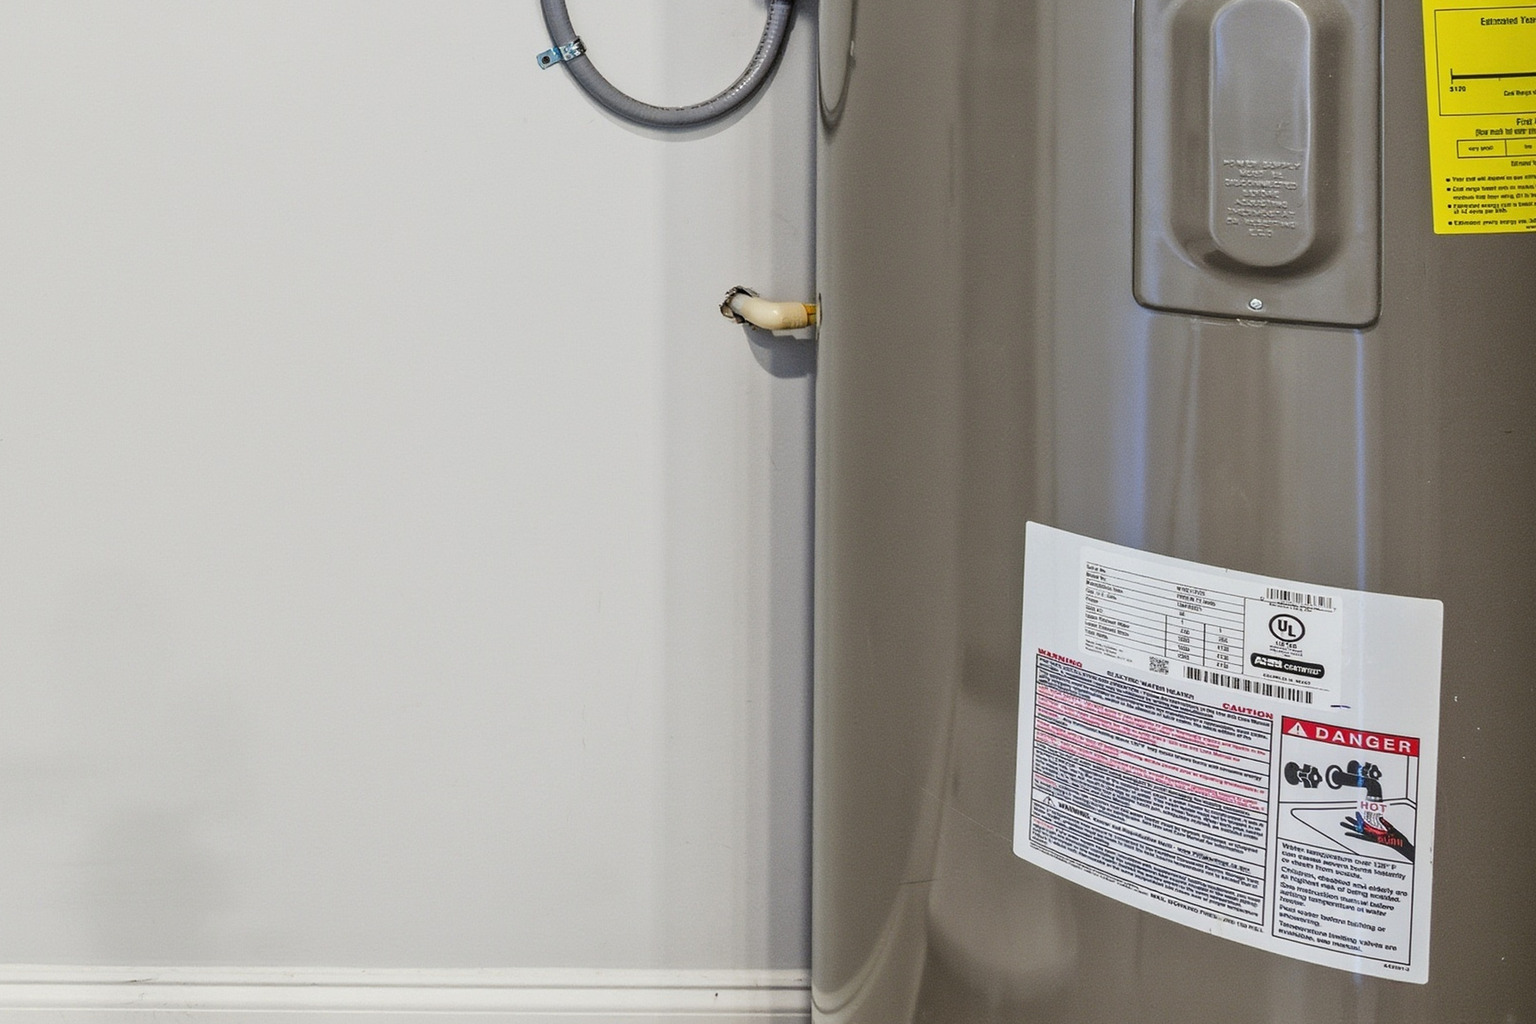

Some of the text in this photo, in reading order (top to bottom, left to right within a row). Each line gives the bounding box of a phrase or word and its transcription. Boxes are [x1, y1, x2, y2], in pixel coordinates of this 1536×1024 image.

[1278, 619, 1296, 637] UL
[1038, 648, 1082, 668] WARNING
[1222, 703, 1273, 720] CAUTION
[1315, 726, 1411, 753] DANGER
[1360, 801, 1387, 813] HOT
